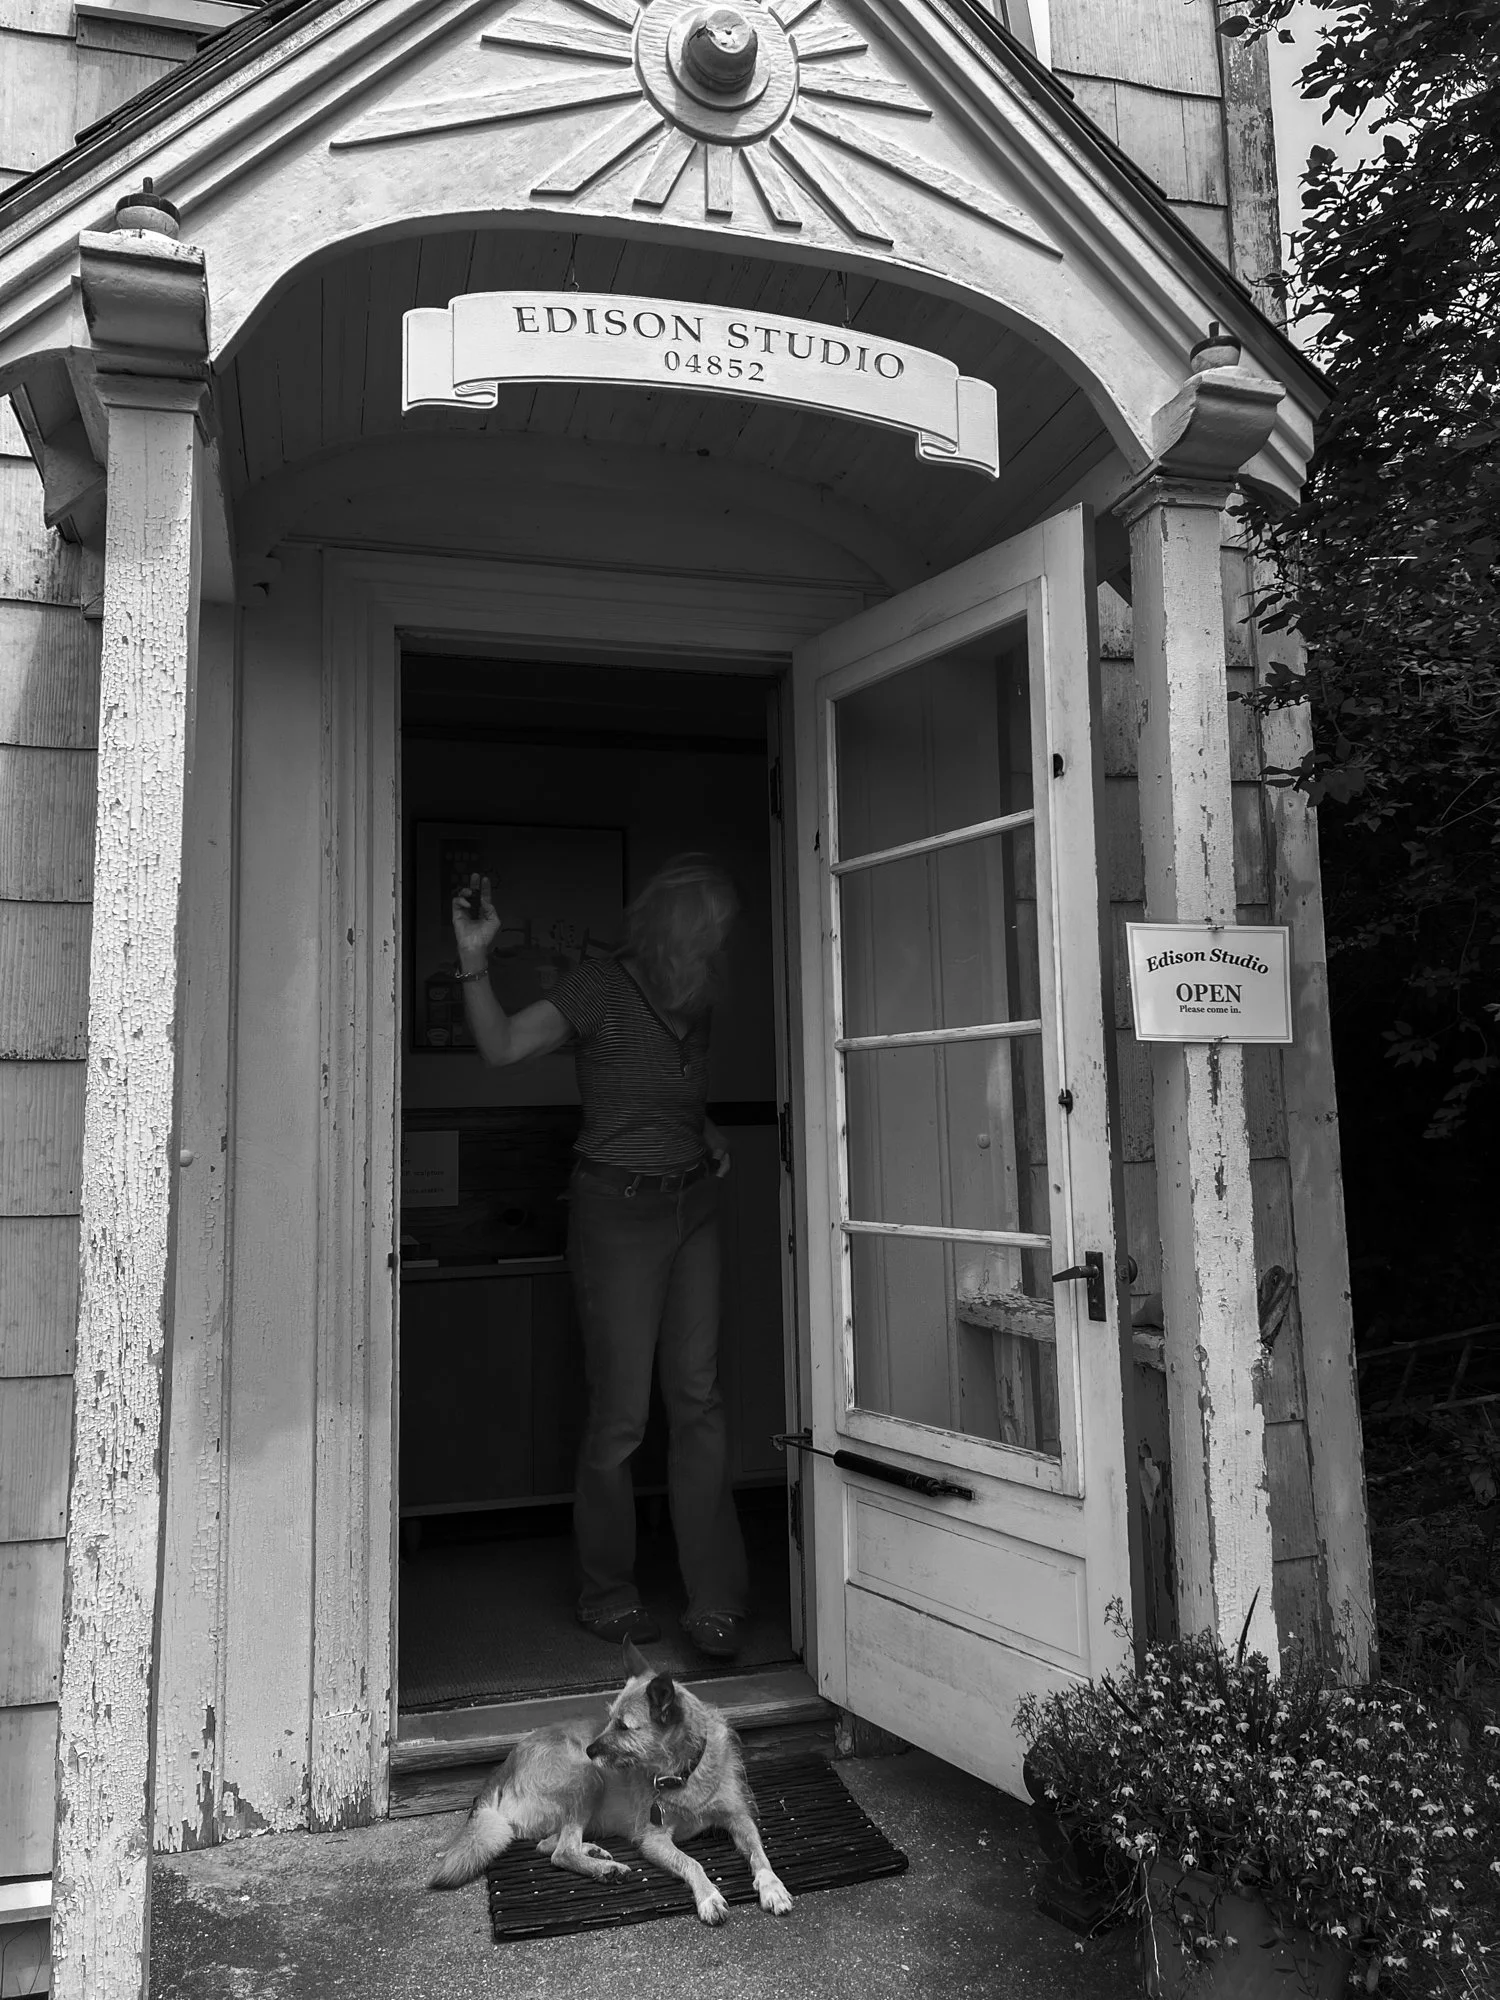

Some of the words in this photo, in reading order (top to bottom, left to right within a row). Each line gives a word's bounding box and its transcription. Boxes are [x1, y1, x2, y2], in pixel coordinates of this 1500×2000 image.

[512, 306, 705, 343] EDISON
[727, 322, 905, 379] STUDIO
[663, 350, 765, 382] 04852
[1146, 950, 1205, 973] Edison
[1209, 948, 1269, 974] Studio
[1176, 983, 1243, 1003] OPEN
[1179, 1005, 1205, 1014] Please
[1206, 1006, 1228, 1014] come
[1230, 1005, 1242, 1014] in.
[413, 1169, 445, 1178] lpture
